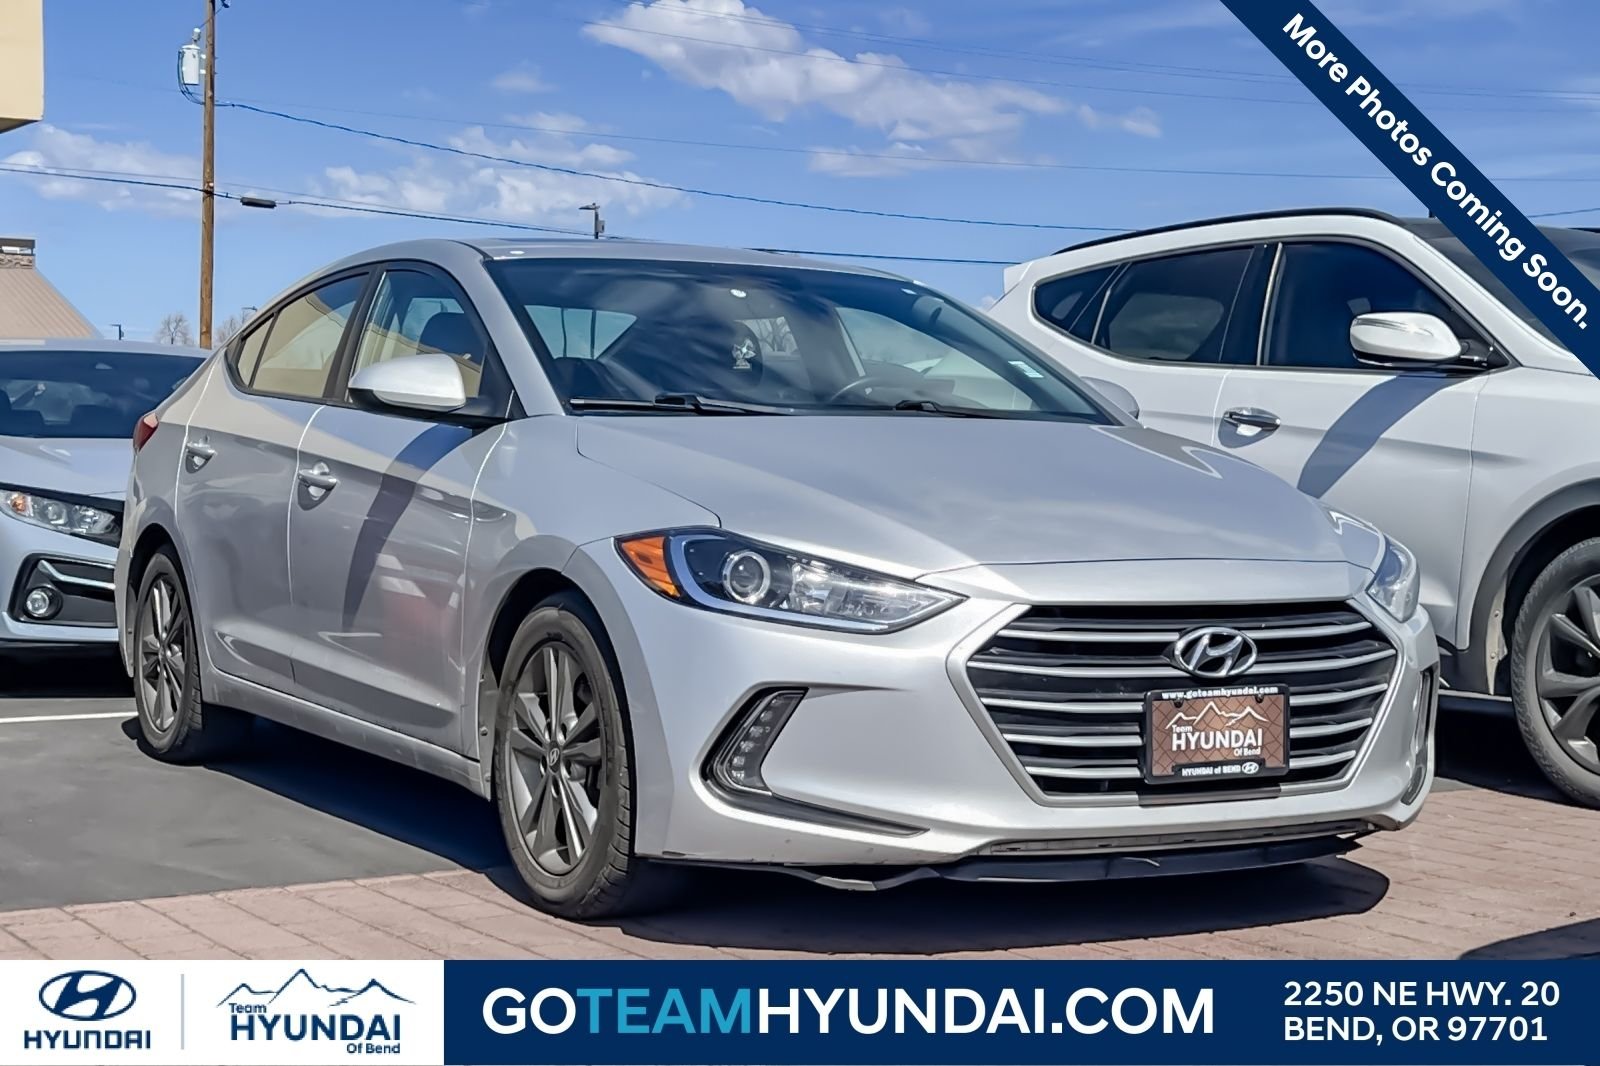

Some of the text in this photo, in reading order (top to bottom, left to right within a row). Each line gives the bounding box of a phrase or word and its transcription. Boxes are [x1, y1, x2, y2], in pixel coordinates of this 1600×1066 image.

[1161, 686, 1279, 700] www.goteamhyundai.com
[1171, 724, 1193, 733] Team
[1171, 728, 1263, 752] HYUNDAI
[1233, 747, 1261, 757] Of Bend
[1181, 764, 1241, 777] HYUNDAI of BEND
